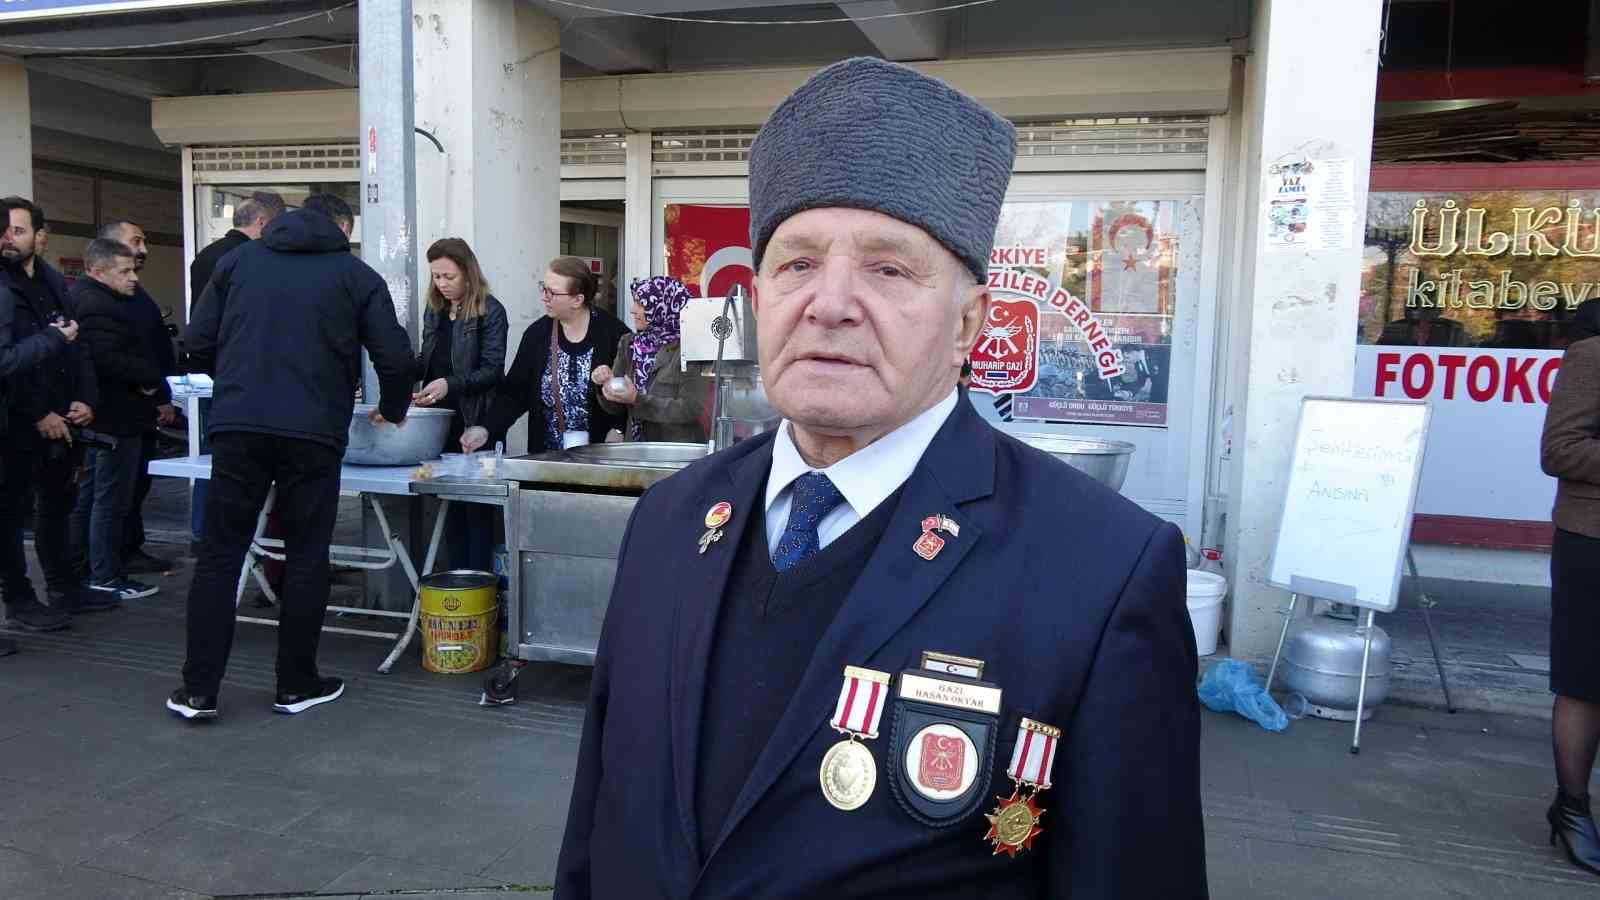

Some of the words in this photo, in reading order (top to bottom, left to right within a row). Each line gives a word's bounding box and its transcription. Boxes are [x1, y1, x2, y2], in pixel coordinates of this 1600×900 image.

[989, 243, 1046, 265] RKİYE
[1406, 268, 1600, 311] kitabev
[988, 267, 1048, 298] ZİLER
[1051, 289, 1124, 377] DERNEĞİ
[1006, 360, 1023, 370] GAZİ
[915, 689, 949, 702] HASAN
